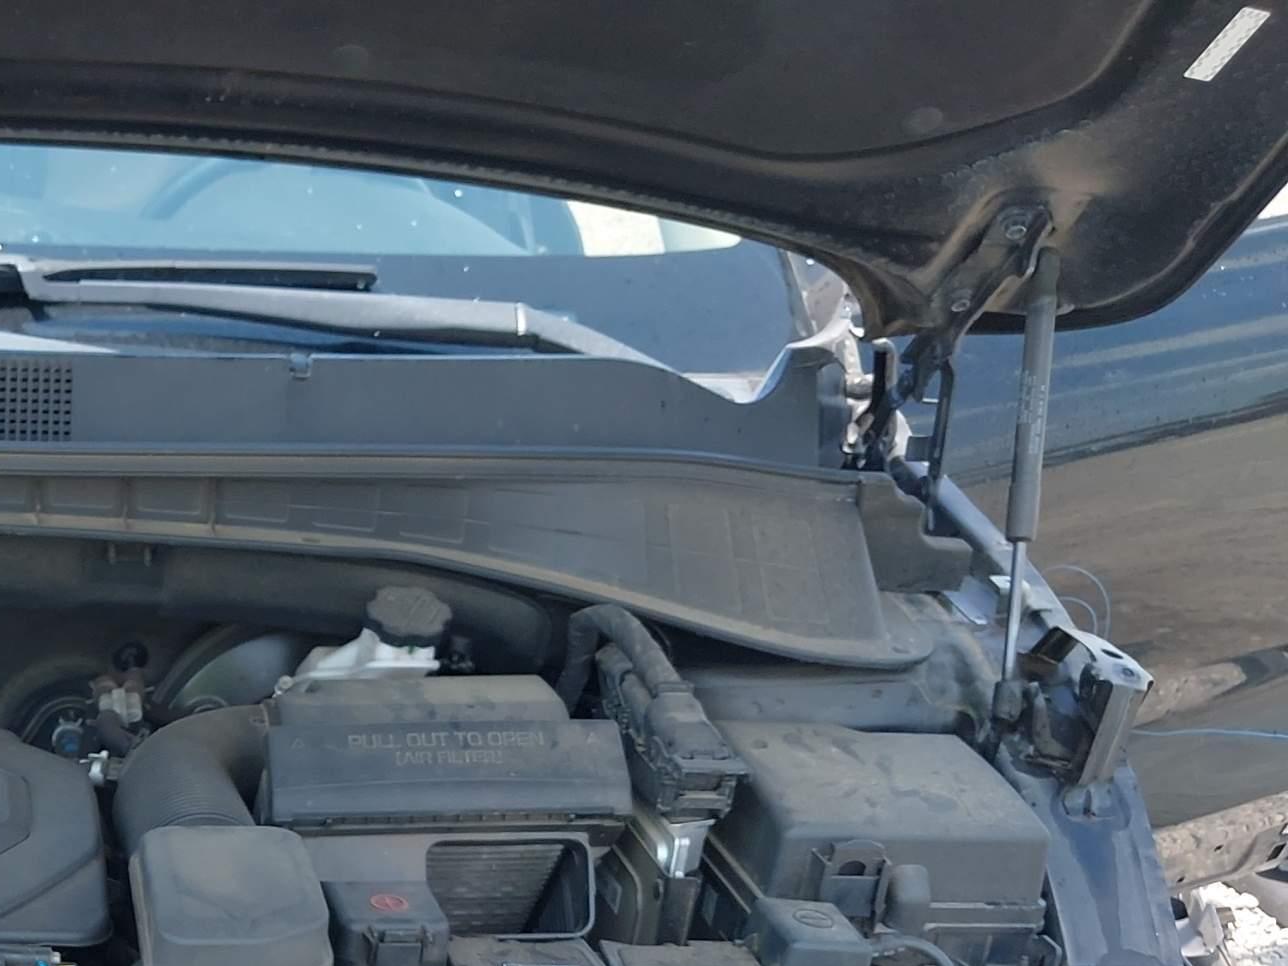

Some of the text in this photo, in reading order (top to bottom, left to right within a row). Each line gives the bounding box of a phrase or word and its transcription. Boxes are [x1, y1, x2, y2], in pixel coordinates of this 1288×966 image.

[347, 731, 545, 749] PULL OUT TO OPEN
